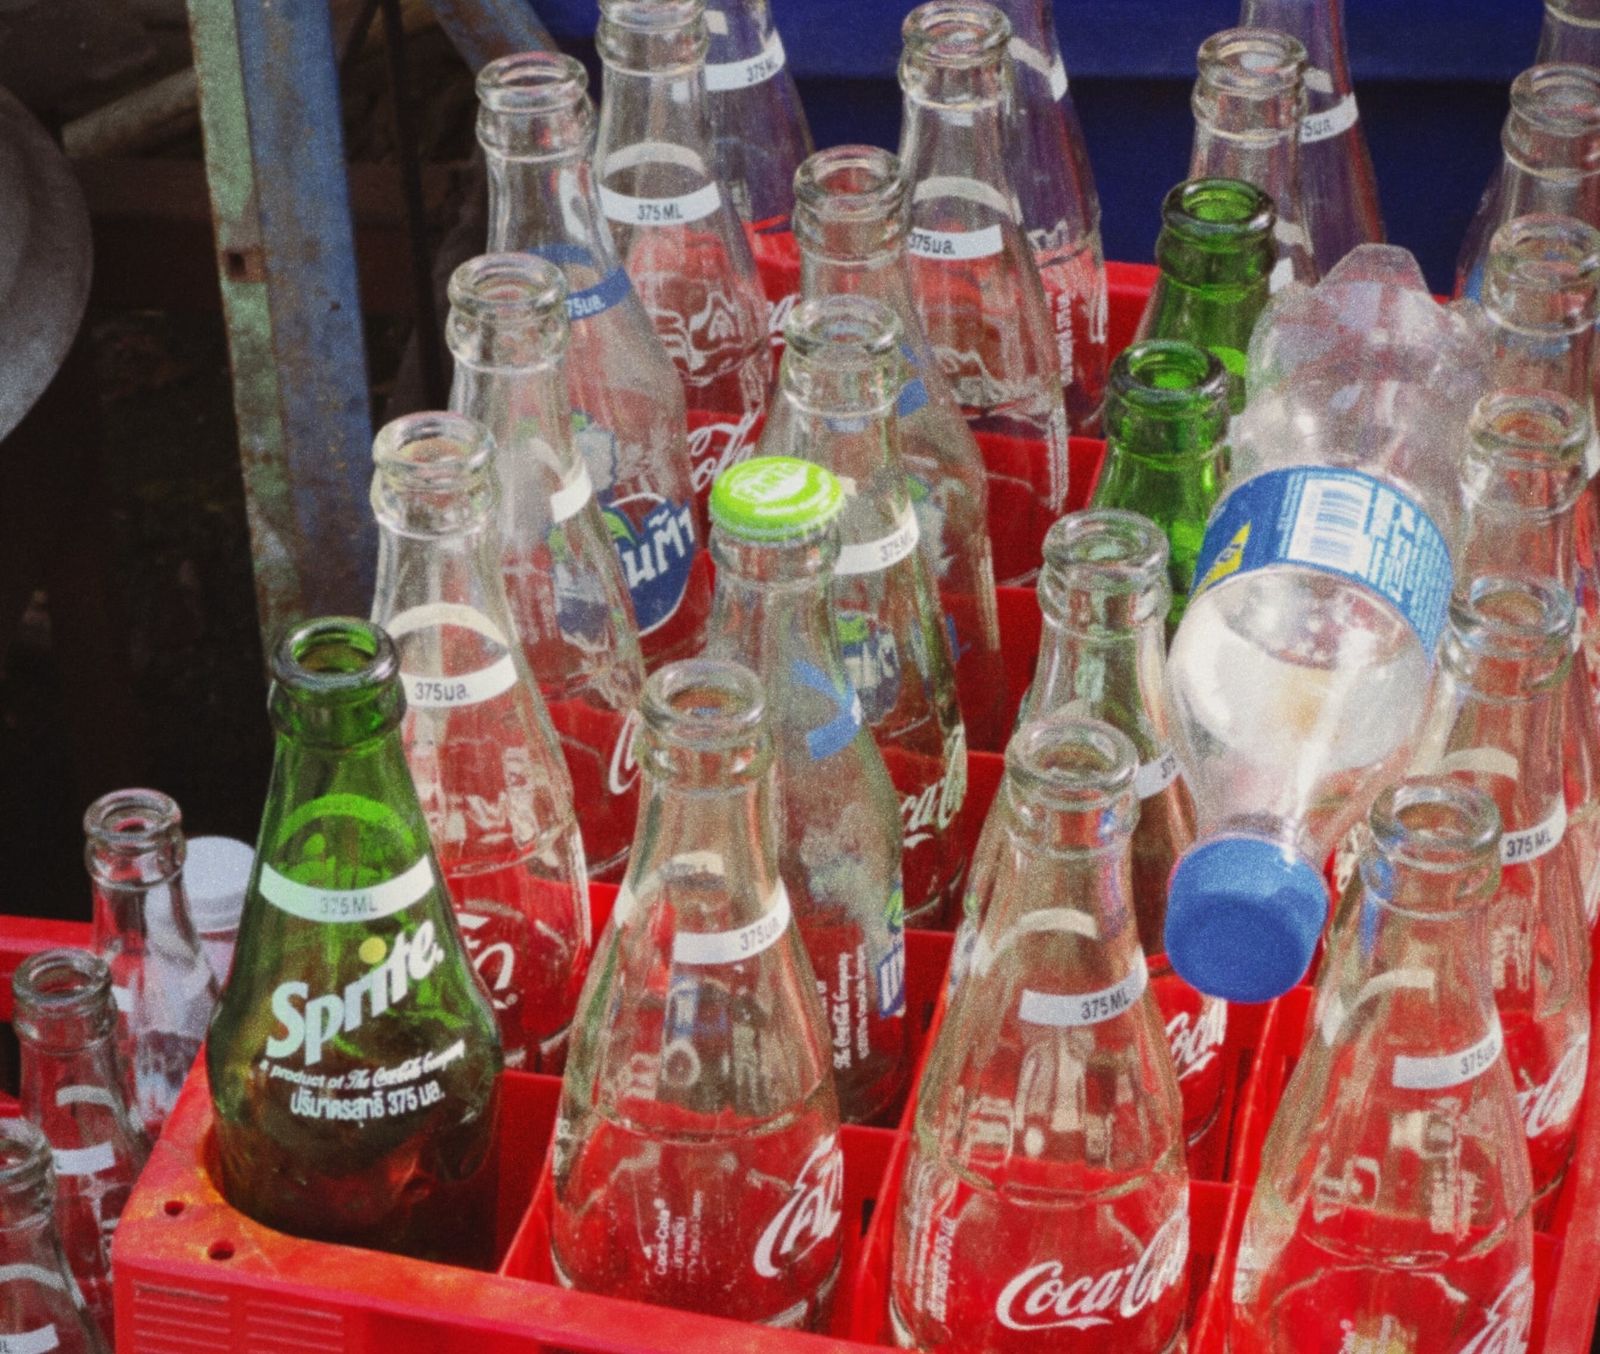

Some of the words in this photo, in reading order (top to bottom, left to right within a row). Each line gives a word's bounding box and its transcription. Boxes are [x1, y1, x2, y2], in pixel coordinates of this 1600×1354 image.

[637, 203, 683, 221] 375ML
[565, 294, 606, 317] 75มล.
[320, 895, 378, 914] 375ML
[266, 919, 437, 1066] Sprite
[1081, 987, 1131, 1020] 375ML
[270, 1064, 325, 1087] product
[327, 1075, 345, 1089] of
[388, 1087, 418, 1117] 375
